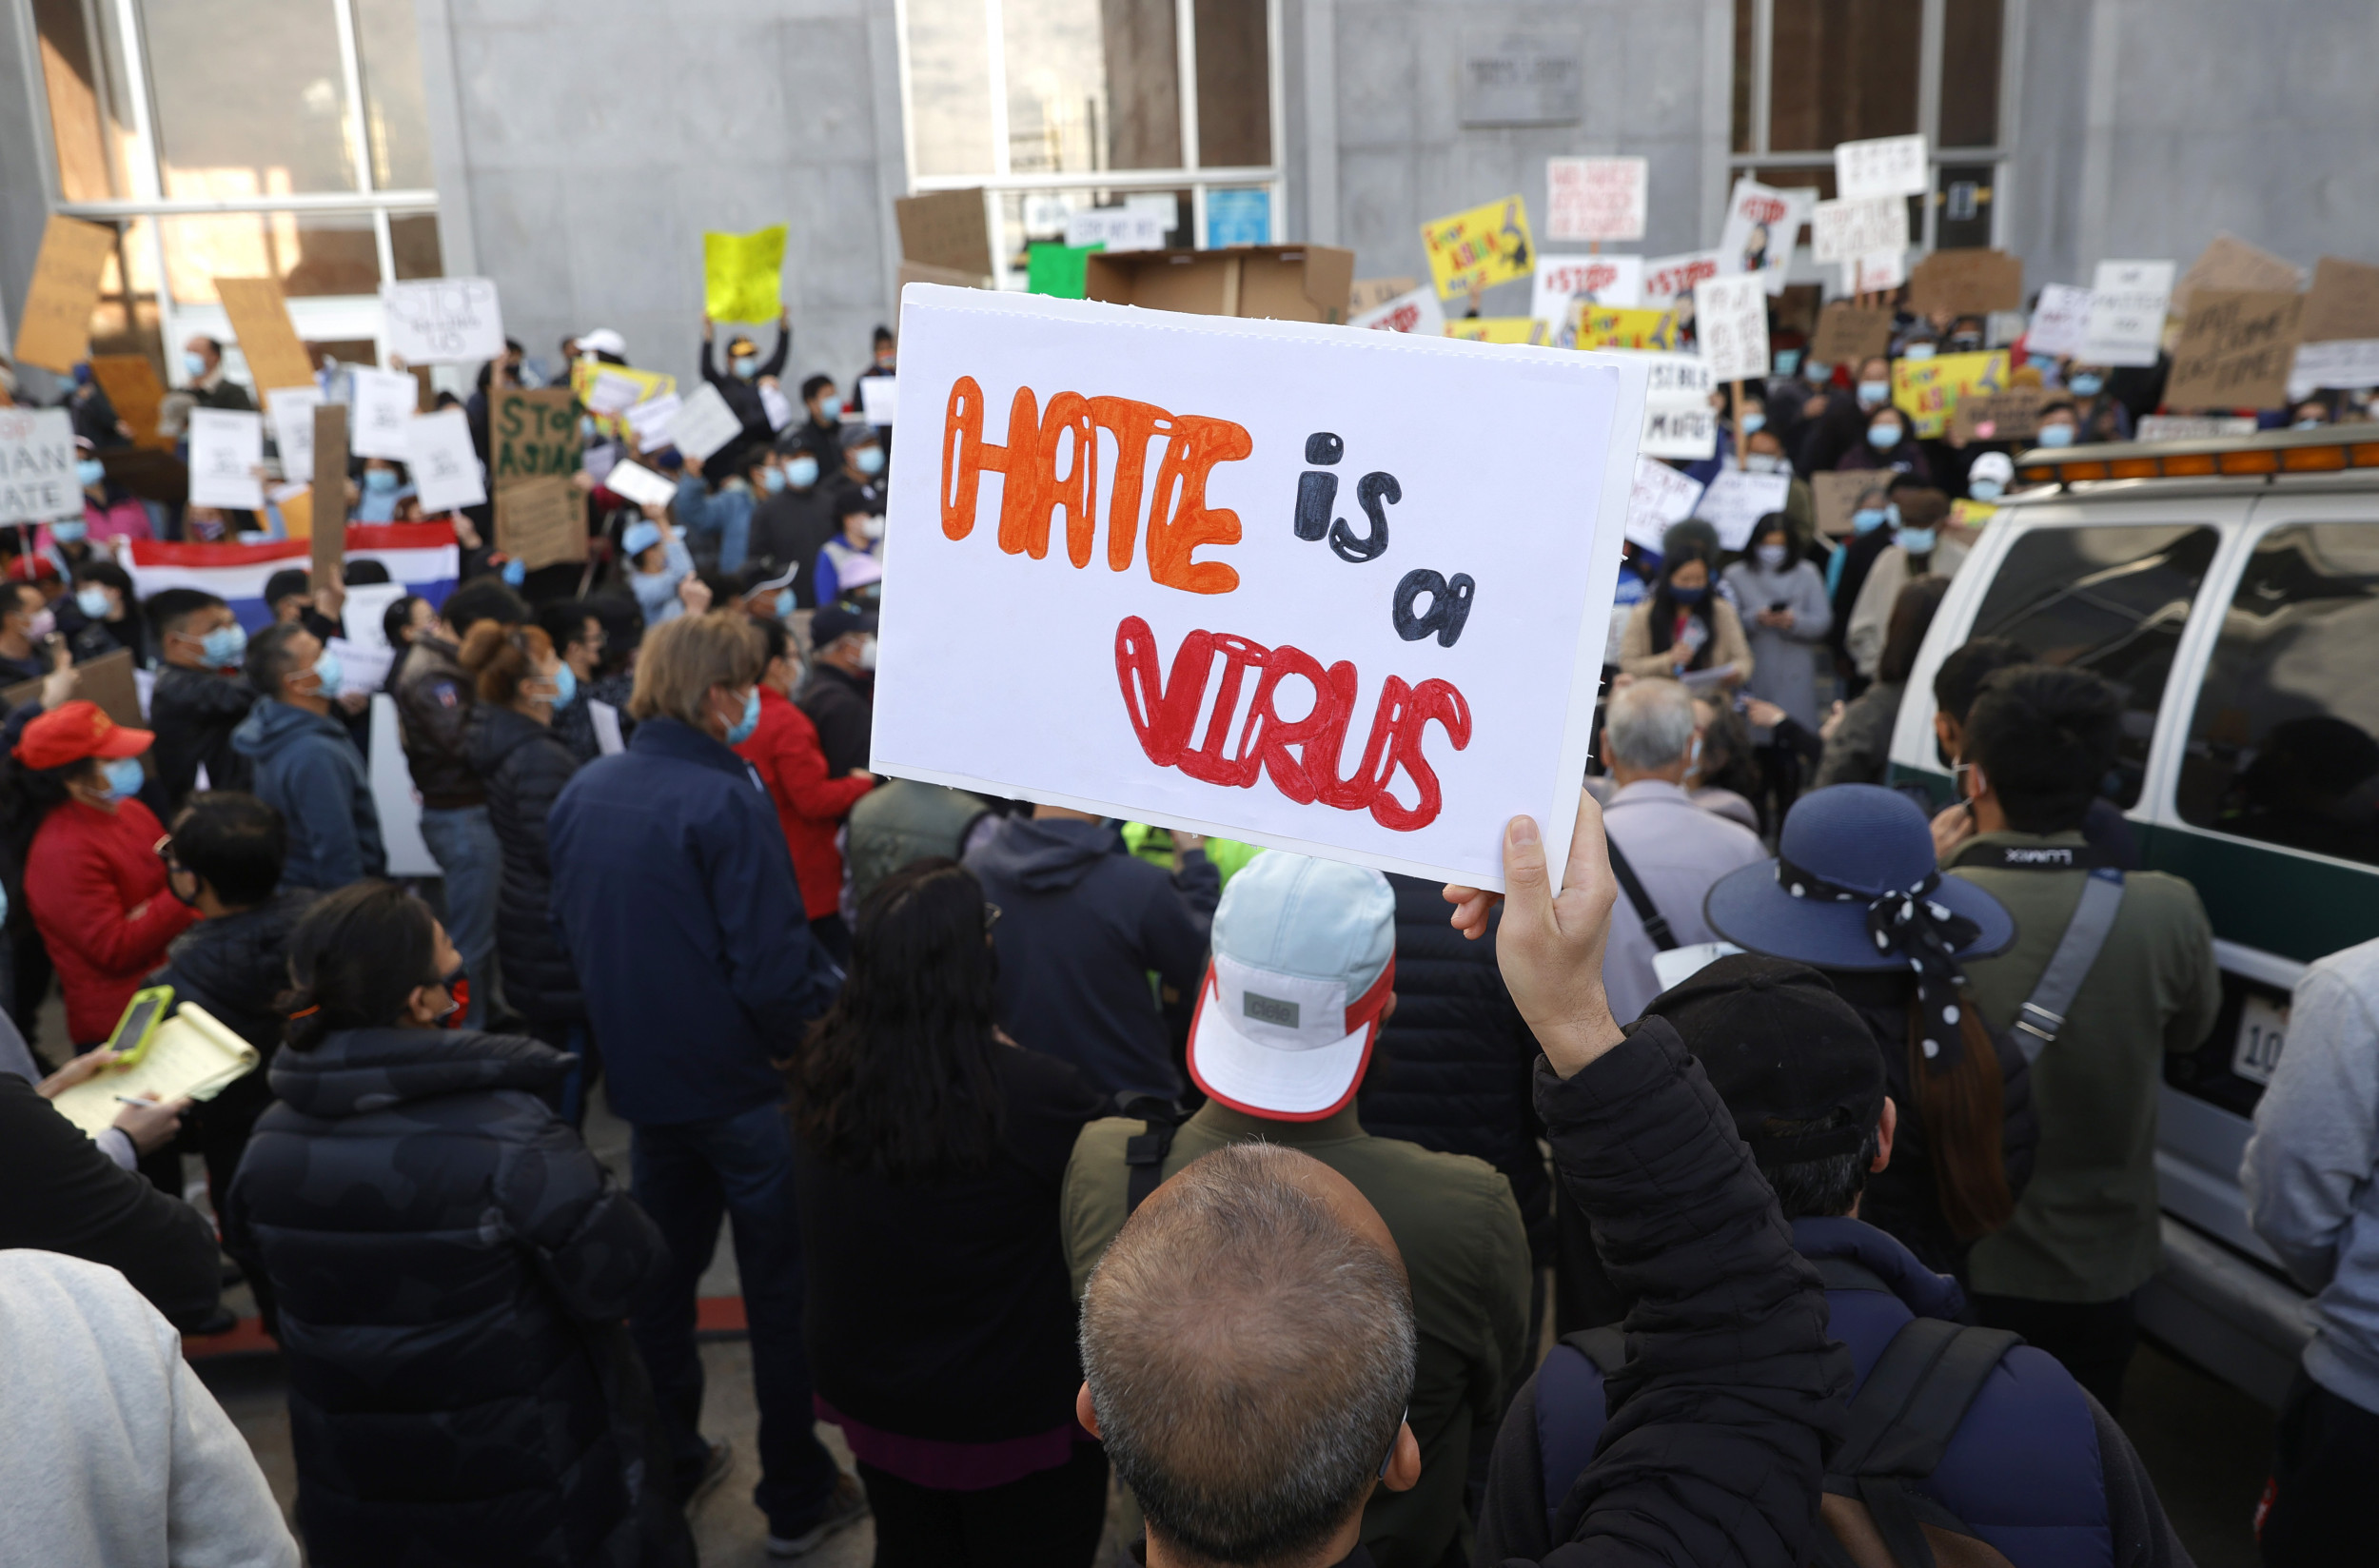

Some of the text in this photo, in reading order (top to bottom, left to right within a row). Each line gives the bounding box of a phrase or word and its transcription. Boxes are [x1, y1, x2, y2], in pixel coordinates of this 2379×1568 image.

[0, 480, 62, 512] ATE
[940, 376, 1403, 595] HATE is
[1392, 569, 1476, 649] a
[1114, 616, 1474, 832] VIRUS
[2005, 847, 2073, 865] LUMIX
